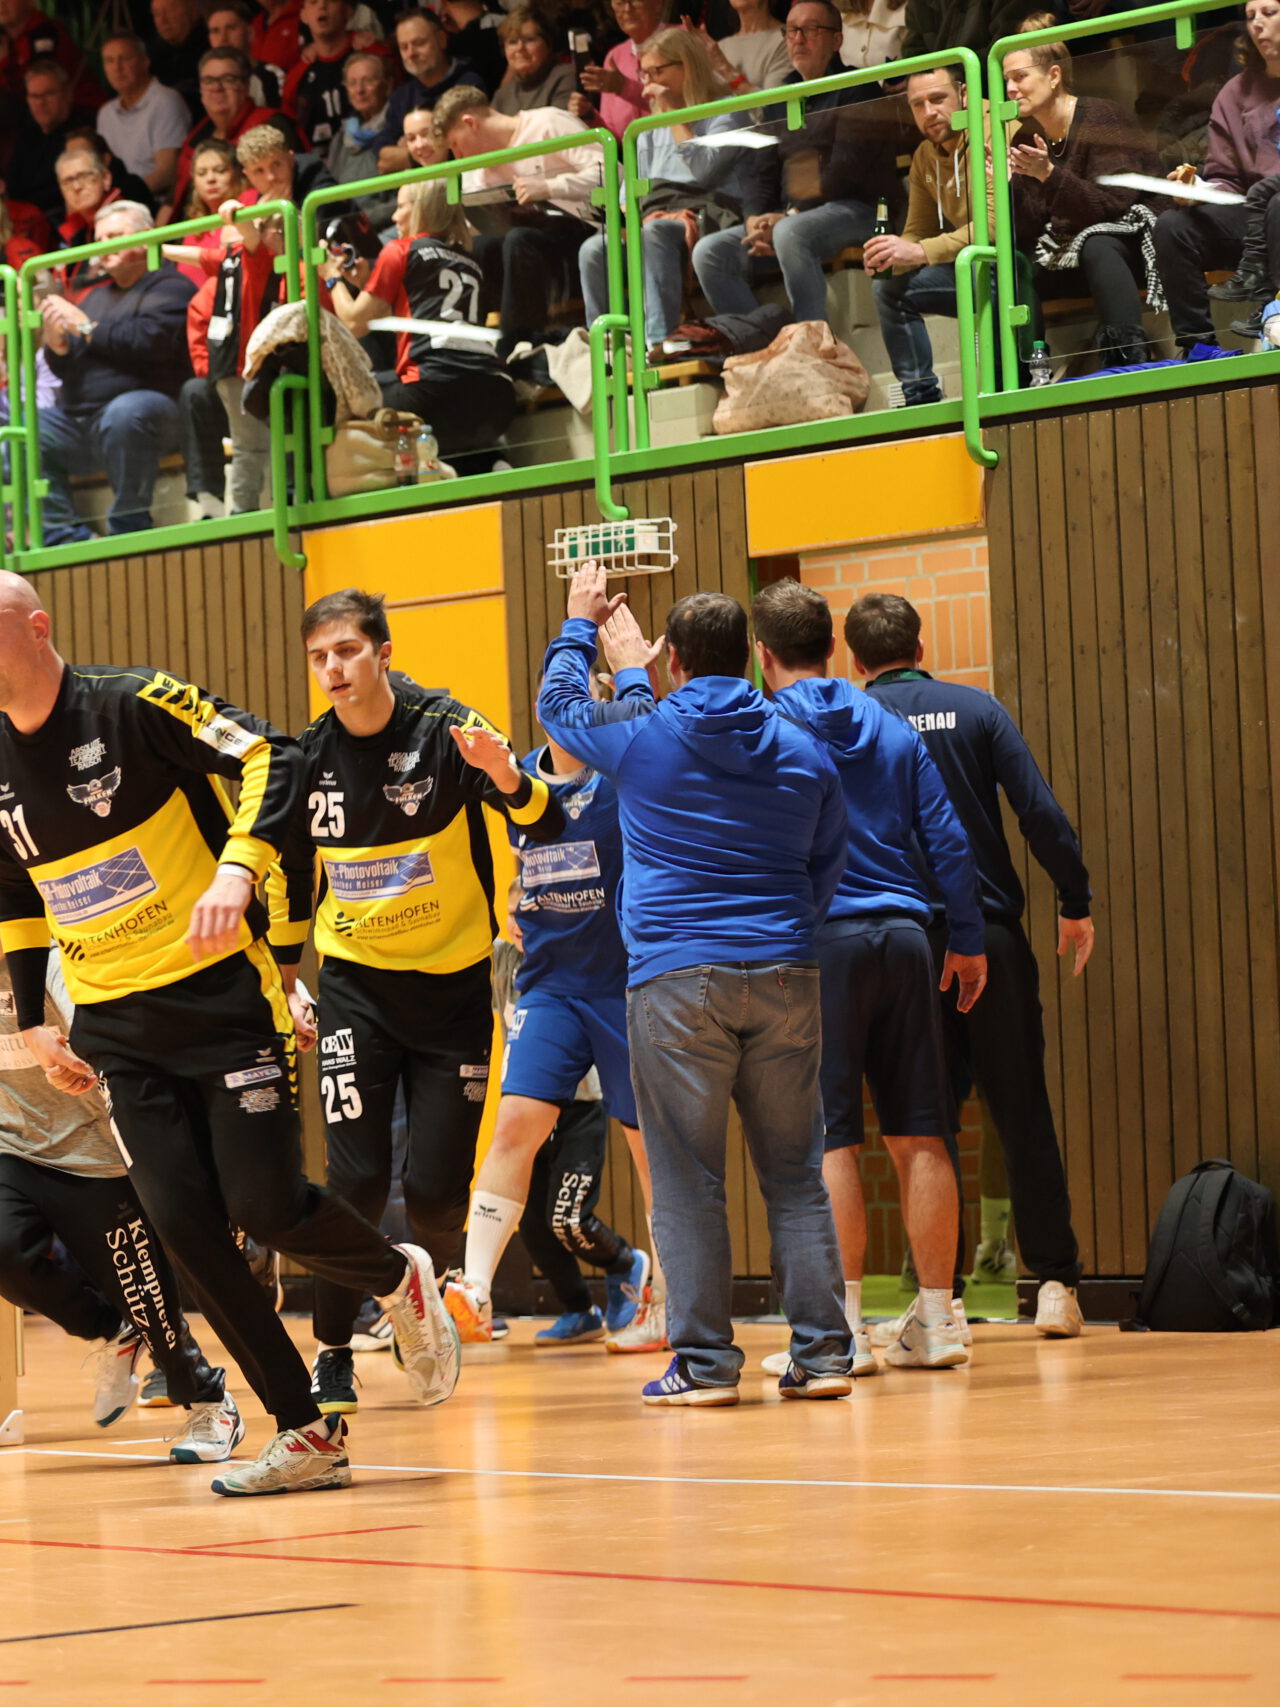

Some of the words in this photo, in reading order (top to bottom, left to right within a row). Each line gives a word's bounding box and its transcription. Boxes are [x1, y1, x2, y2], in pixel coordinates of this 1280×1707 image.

[0, 803, 40, 860] 31
[308, 791, 346, 838] 25
[356, 900, 440, 929] ALTENHOFEN
[537, 887, 605, 905] ALTENHOFEN
[321, 1072, 363, 1125] 25
[105, 1227, 150, 1329] Schütz
[127, 1216, 178, 1350] Klempnerei
